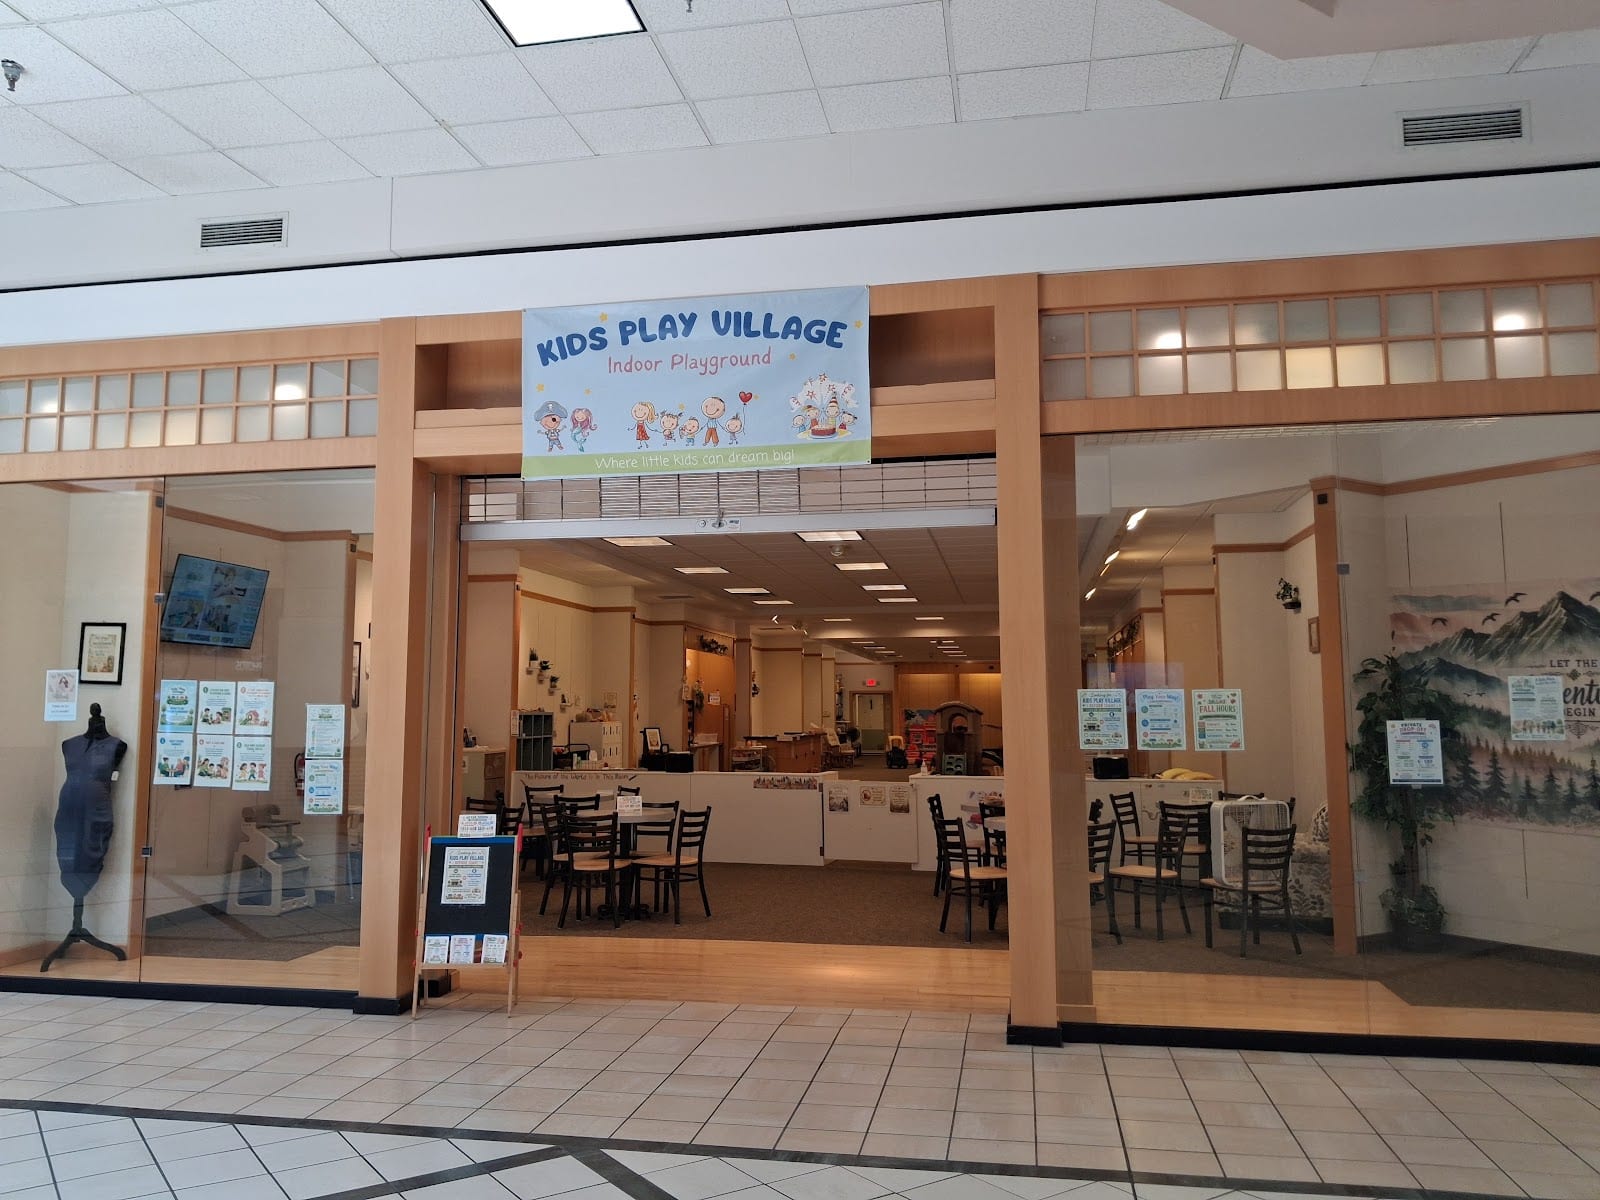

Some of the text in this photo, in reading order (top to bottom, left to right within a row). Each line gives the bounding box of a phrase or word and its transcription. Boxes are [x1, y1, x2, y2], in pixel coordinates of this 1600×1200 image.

[536, 310, 848, 366] KIDS PLAY VILLAGE
[608, 346, 772, 376] Indoor Playground
[595, 449, 795, 469] Where little kids can dream big!
[1550, 659, 1598, 668] LET THE
[1199, 704, 1236, 713] FALL HOURS
[1564, 707, 1596, 717] EGIN
